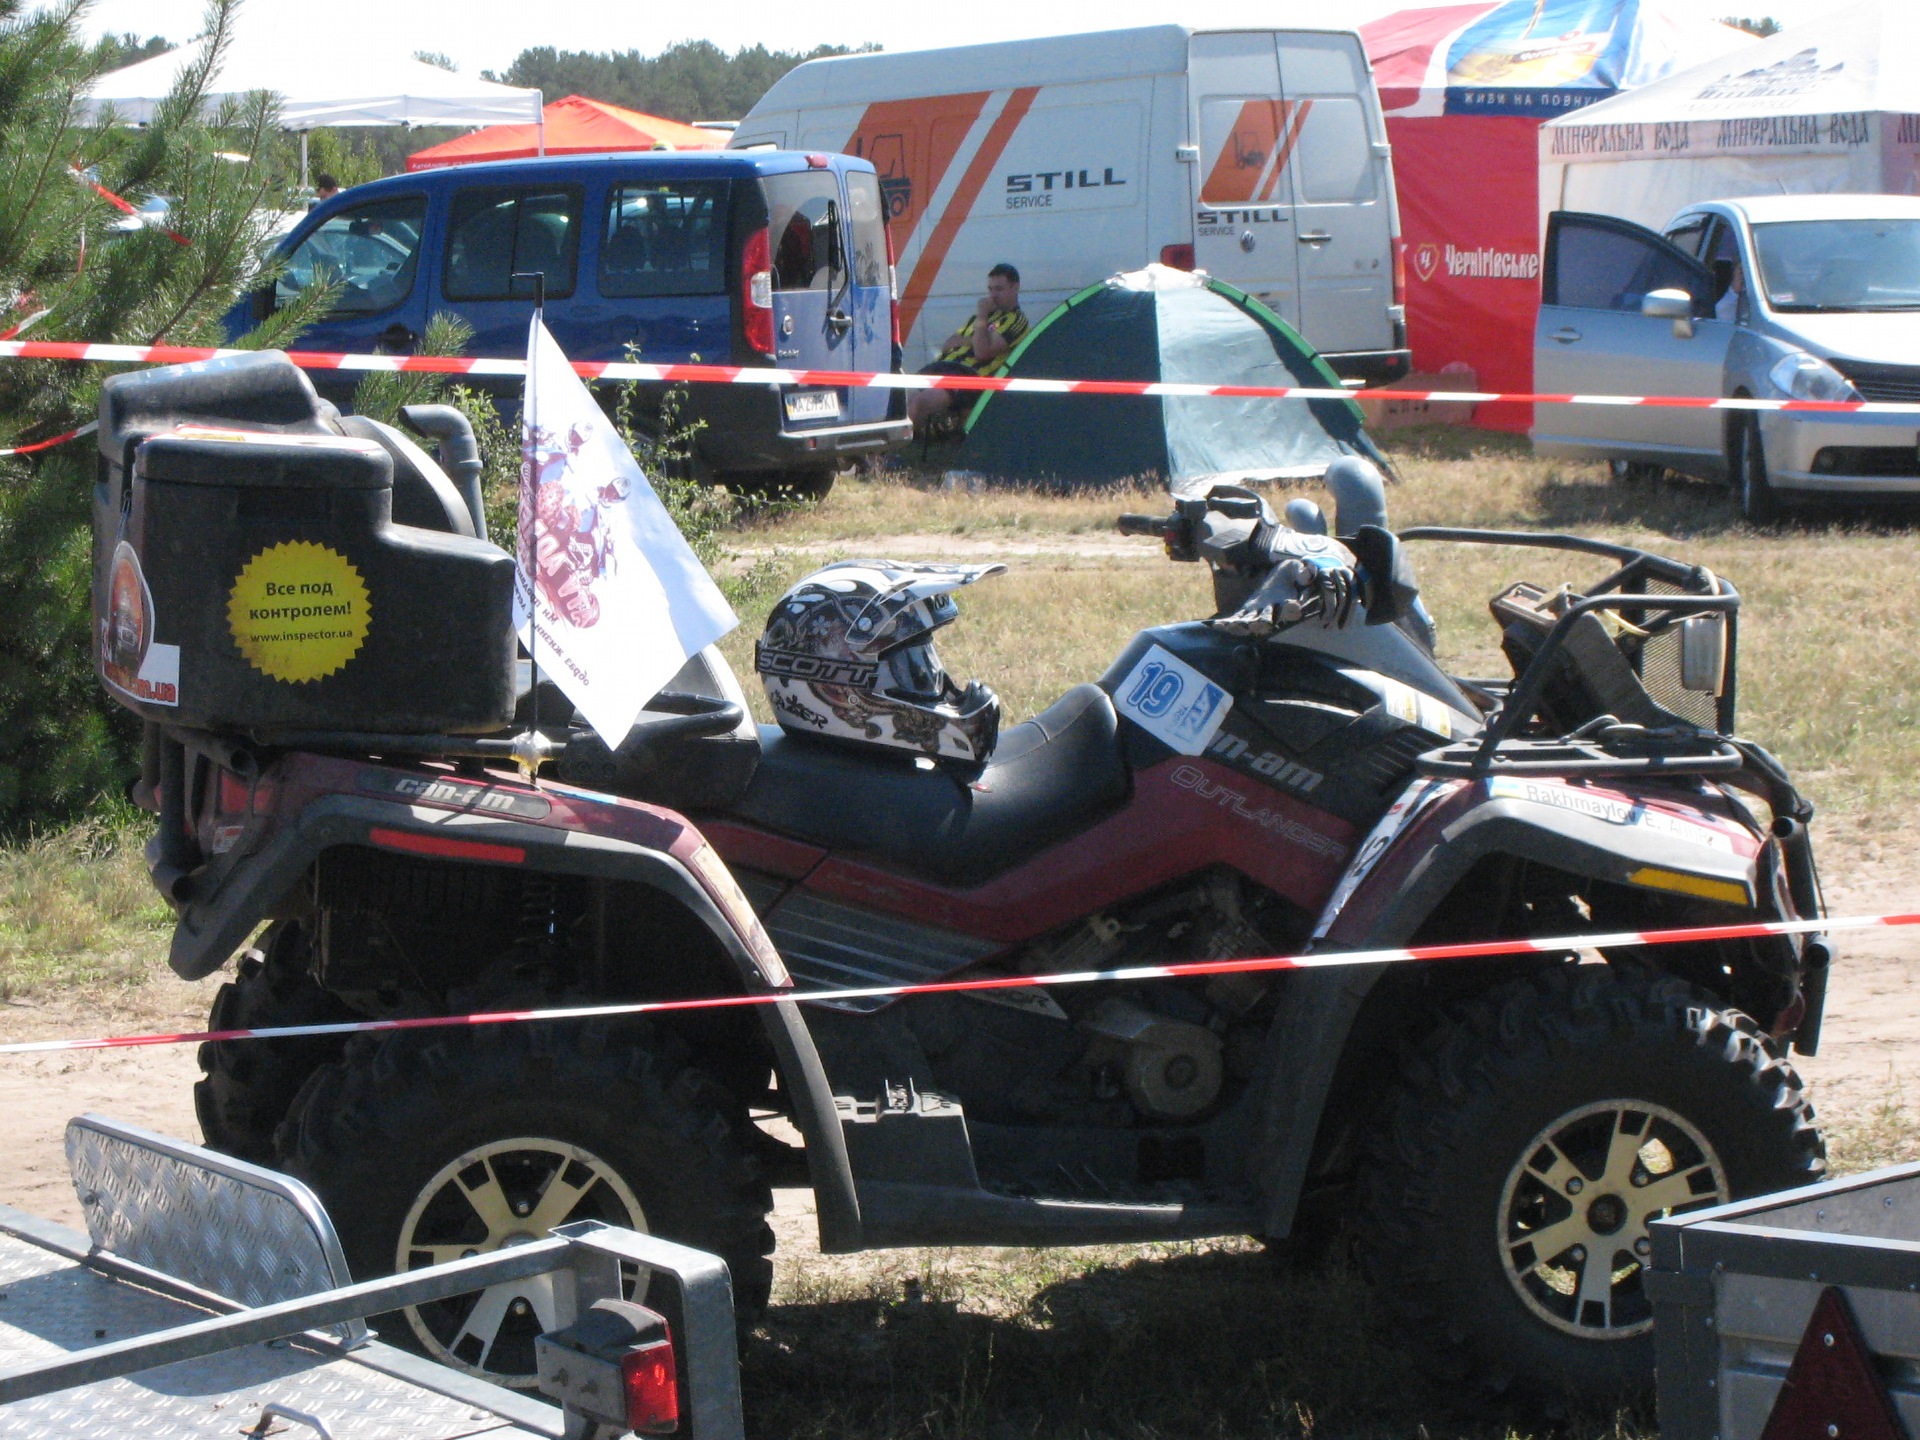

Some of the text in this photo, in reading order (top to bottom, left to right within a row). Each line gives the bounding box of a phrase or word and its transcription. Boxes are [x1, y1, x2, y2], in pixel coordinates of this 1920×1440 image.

[1464, 92, 1506, 105] ЖИВИ
[1514, 94, 1533, 106] НА
[1006, 167, 1126, 194] STILL
[1006, 194, 1053, 210] SERVICE
[1197, 209, 1289, 225] STILL
[1198, 226, 1234, 237] SERVICE
[1444, 243, 1539, 279] Чернігівське
[265, 581, 333, 597] Все под
[249, 600, 351, 621] контролем!
[250, 629, 353, 642] www.inspector.ua
[758, 653, 875, 686] SCOTT
[1127, 661, 1184, 718] 19
